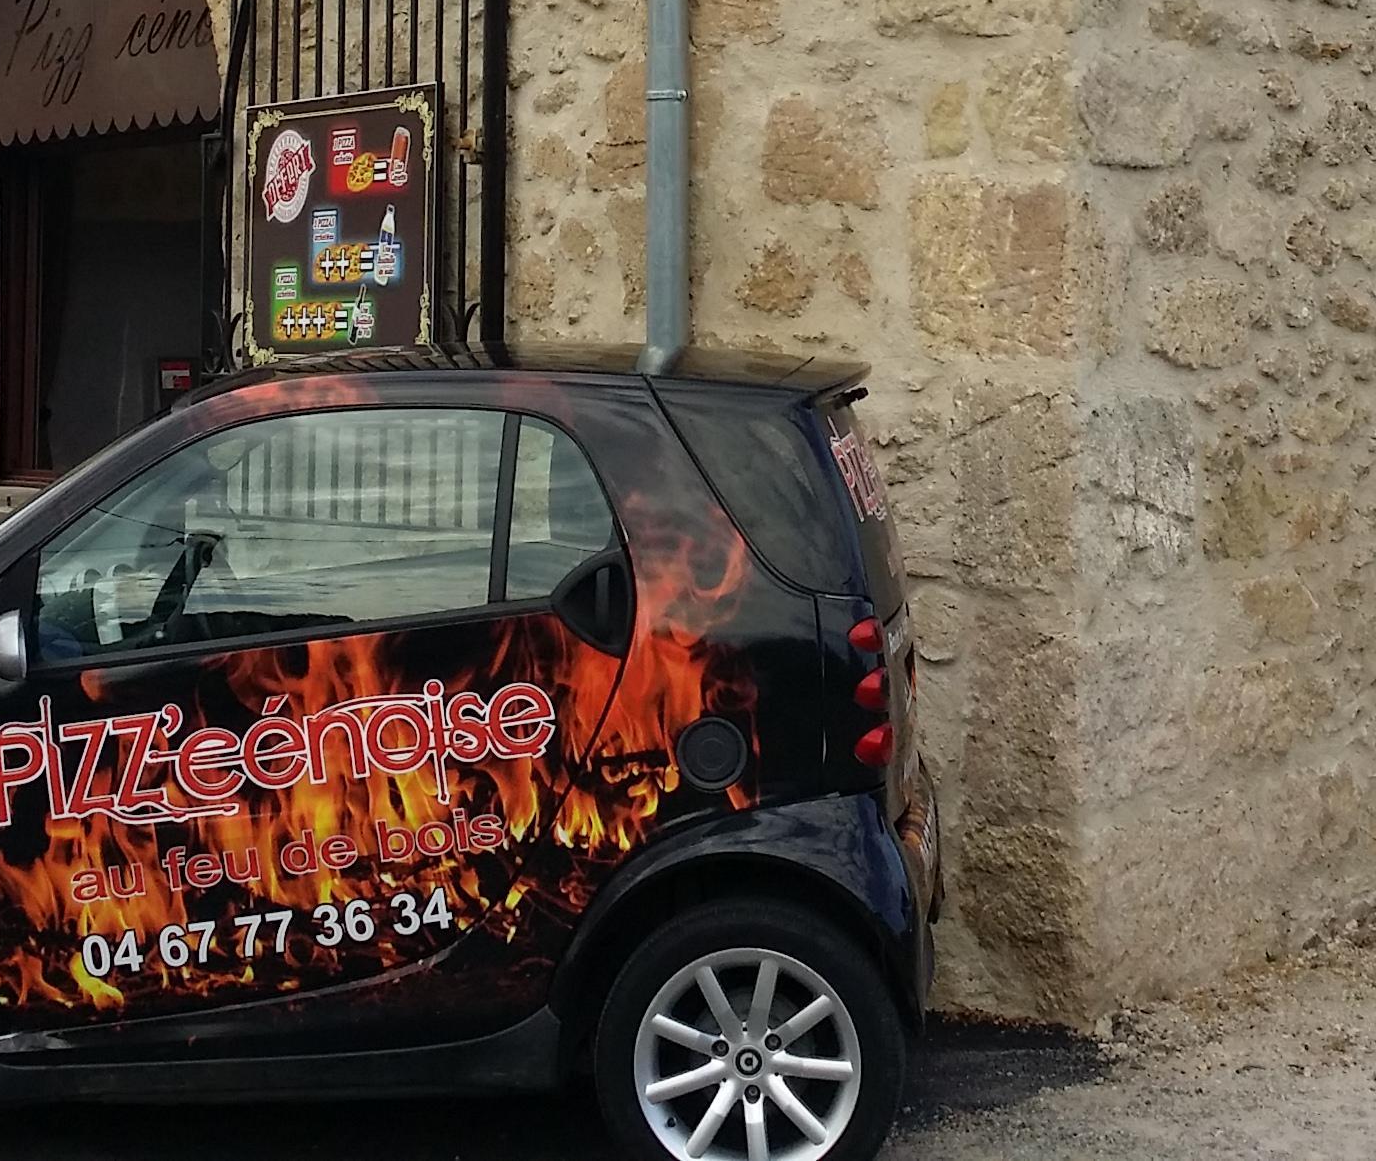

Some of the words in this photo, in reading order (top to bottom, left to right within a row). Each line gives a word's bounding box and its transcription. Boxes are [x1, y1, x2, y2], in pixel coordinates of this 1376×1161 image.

[71, 861, 147, 903] au
[163, 845, 262, 892] feu
[280, 828, 358, 876] de
[376, 808, 506, 863] bois
[82, 933, 144, 977] 04
[158, 921, 217, 968] 67
[234, 909, 294, 958] 77
[312, 900, 375, 947] 36
[390, 887, 453, 935] 34
